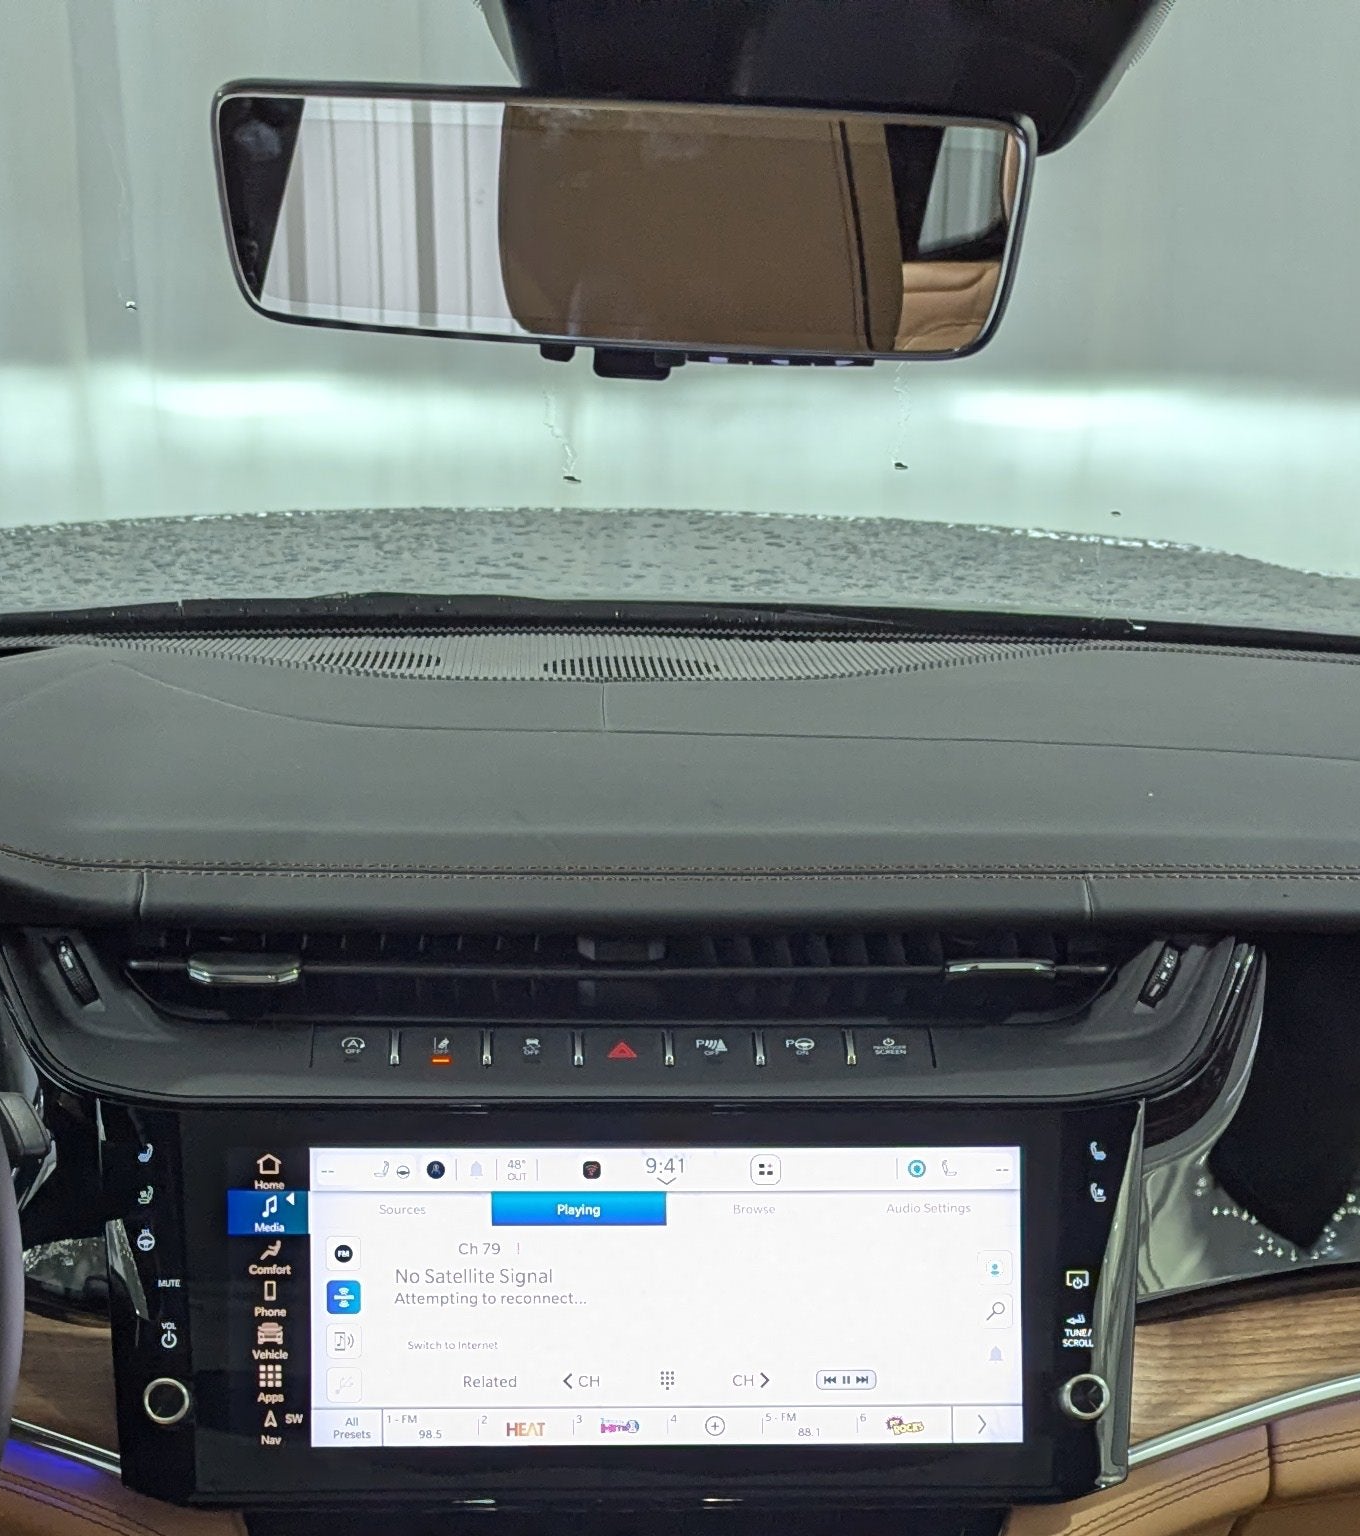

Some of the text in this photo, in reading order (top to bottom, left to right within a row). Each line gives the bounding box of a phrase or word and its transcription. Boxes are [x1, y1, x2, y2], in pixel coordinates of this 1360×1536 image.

[507, 1159, 526, 1170] 48°
[645, 1157, 684, 1174] 9:41
[507, 1172, 527, 1181] OUT
[254, 1180, 285, 1190] Home
[379, 1204, 426, 1216] Sources
[557, 1203, 601, 1217] Playing
[733, 1204, 776, 1215] Browse
[886, 1202, 971, 1216] Audio Settings
[254, 1222, 285, 1233] Media
[337, 1250, 350, 1258] FM
[458, 1242, 501, 1255] Ch 79
[248, 1263, 292, 1275] Comfort
[158, 1279, 181, 1288] MUTE
[395, 1268, 553, 1288] No Satellite Signal
[394, 1292, 587, 1307] Attempting to reconnect...
[254, 1306, 287, 1318] Phone
[161, 1321, 177, 1330] VOL
[1064, 1328, 1093, 1337] TUNE/
[407, 1340, 498, 1351] Switch to Internet
[1062, 1338, 1094, 1348] SCROLL
[251, 1349, 289, 1360] Vehicle
[463, 1375, 517, 1388] Related
[578, 1375, 600, 1388] CH
[732, 1374, 754, 1387] CH
[257, 1392, 285, 1404] Apps
[285, 1413, 304, 1424] SW
[345, 1417, 359, 1426] All
[387, 1415, 391, 1424] 1
[401, 1414, 417, 1424] FM
[481, 1415, 487, 1424] 2
[576, 1415, 583, 1424] 3
[670, 1414, 677, 1423] 4
[766, 1413, 772, 1422] 5
[781, 1412, 797, 1422] FM
[859, 1413, 866, 1422] 6
[333, 1429, 371, 1439] Presets
[418, 1429, 442, 1439] 98.5
[506, 1422, 545, 1437] HEAT
[798, 1427, 820, 1437] 88.1
[261, 1435, 282, 1445] Nav
